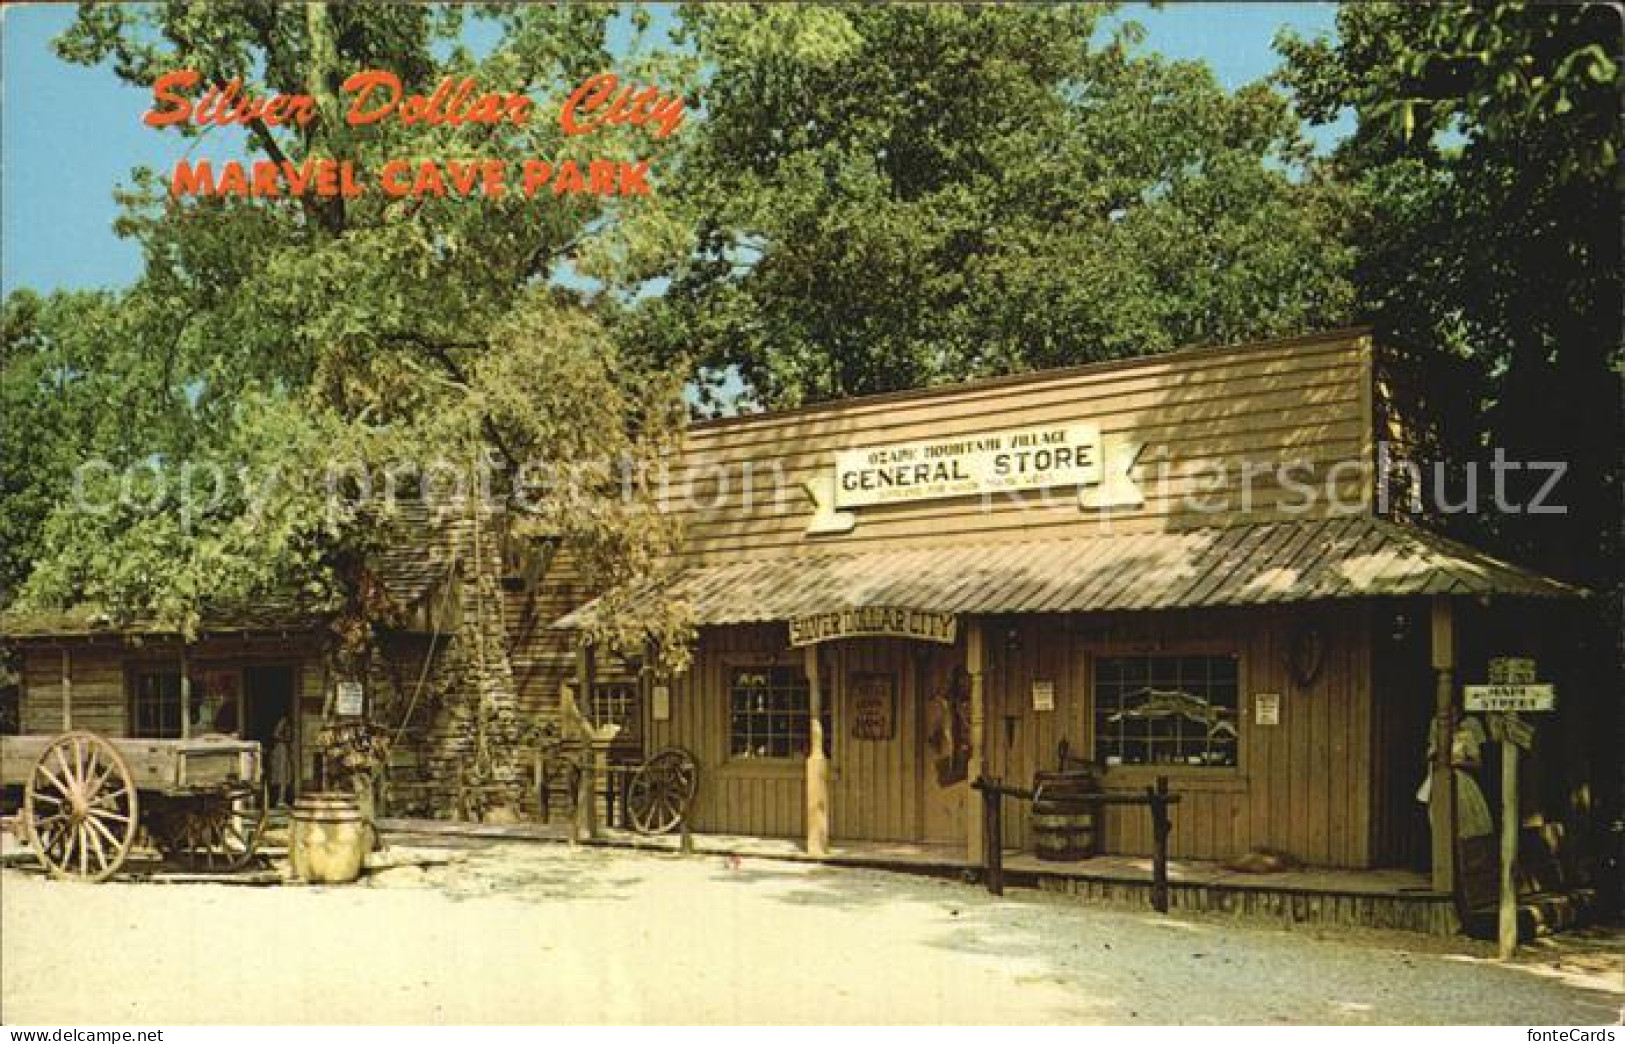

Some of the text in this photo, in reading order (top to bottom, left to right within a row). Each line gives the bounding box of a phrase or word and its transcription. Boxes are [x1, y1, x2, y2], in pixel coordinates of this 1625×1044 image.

[842, 459, 970, 492] GENERAL
[994, 444, 1093, 475] STORE
[791, 605, 952, 642] SILVER DOLLAR CITY
[1480, 697, 1536, 709] STREET
